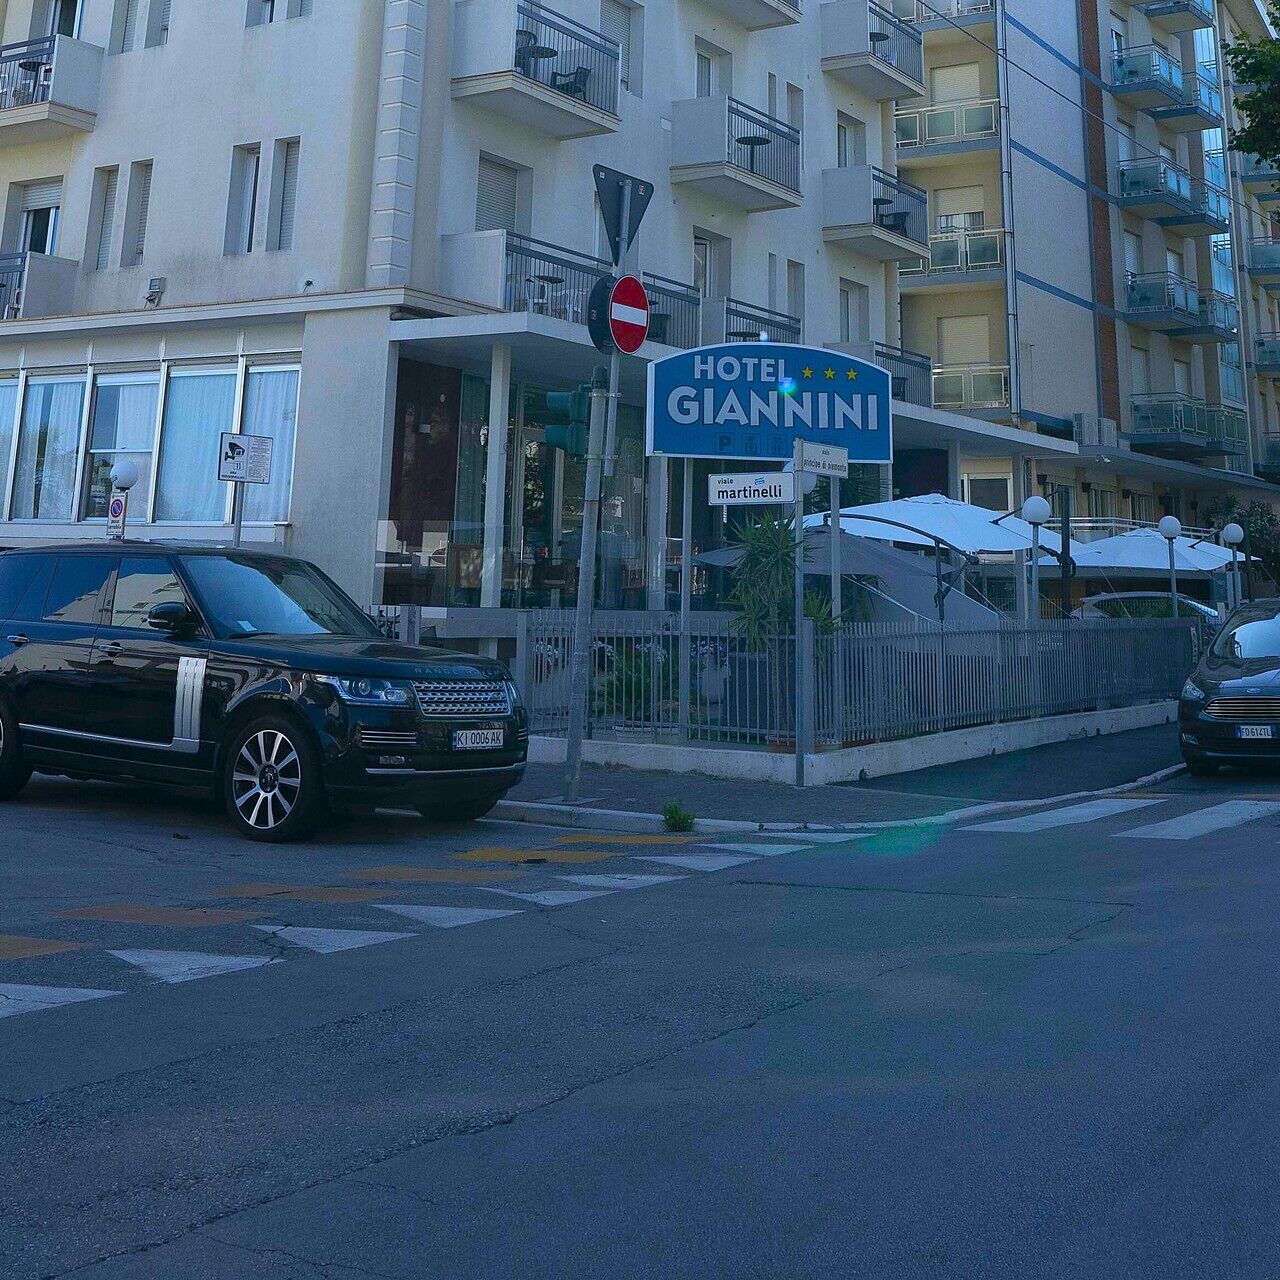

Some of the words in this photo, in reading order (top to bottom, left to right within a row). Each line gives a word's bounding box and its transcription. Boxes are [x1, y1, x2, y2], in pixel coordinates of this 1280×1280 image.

[694, 355, 793, 382] HOTEL
[667, 385, 878, 430] GIANNINI
[803, 458, 821, 470] principe
[827, 462, 847, 472] piemonte
[717, 477, 734, 485] viale
[717, 484, 782, 500] martinelli
[457, 731, 468, 747] KI
[471, 731, 490, 746] 0006
[491, 731, 501, 745] AK
